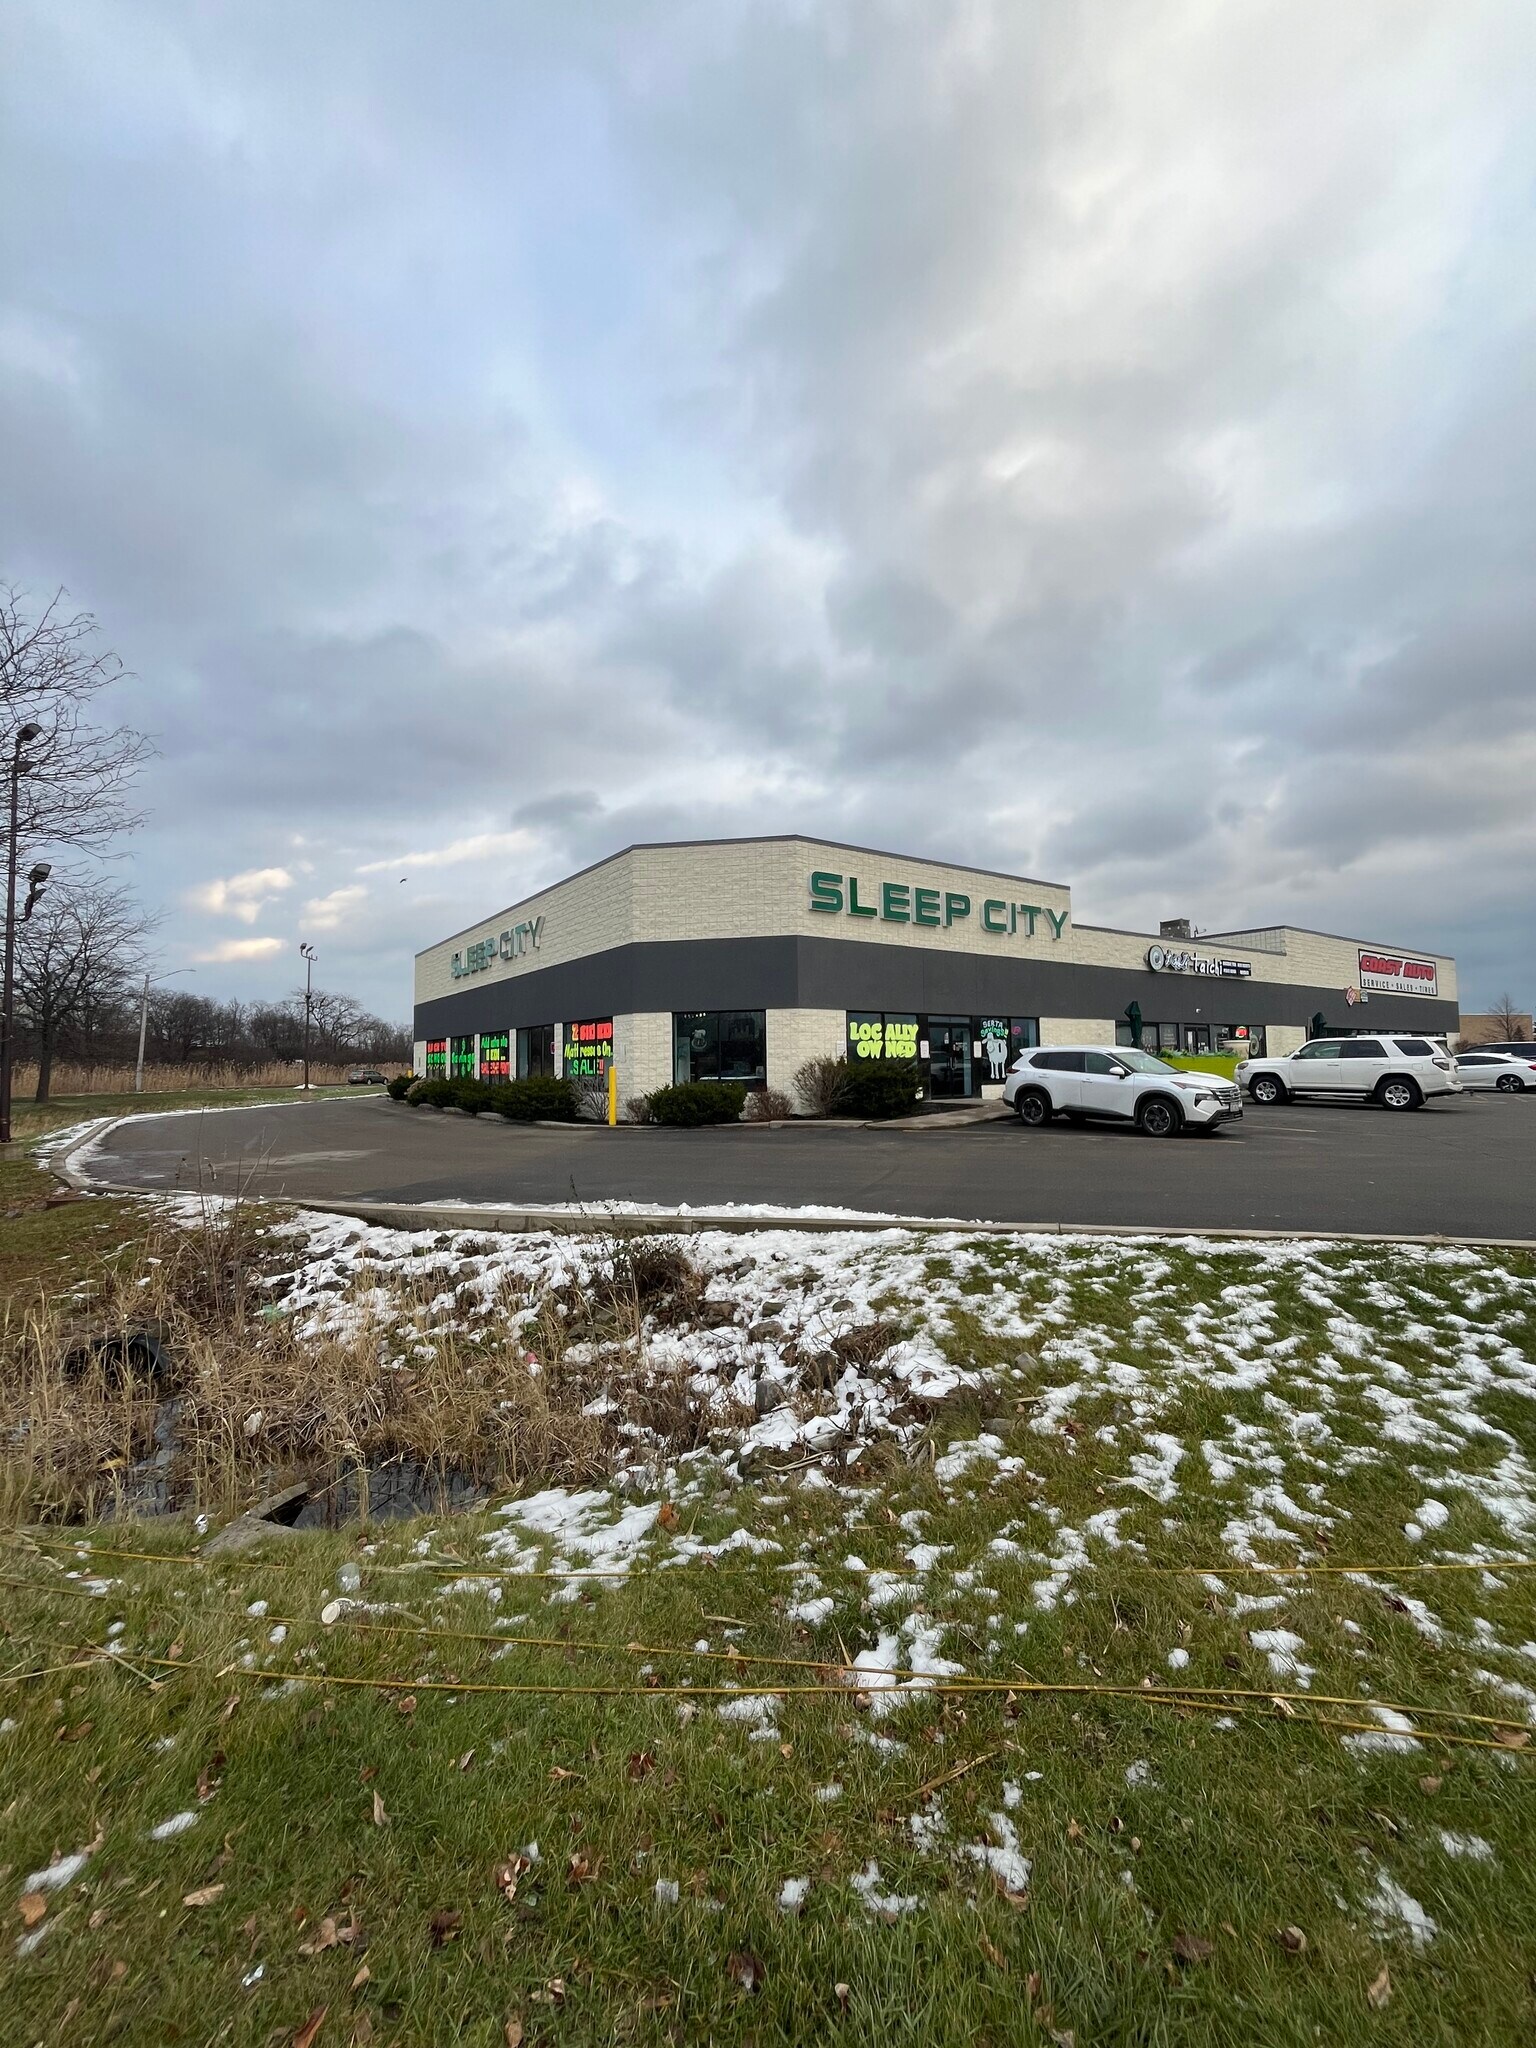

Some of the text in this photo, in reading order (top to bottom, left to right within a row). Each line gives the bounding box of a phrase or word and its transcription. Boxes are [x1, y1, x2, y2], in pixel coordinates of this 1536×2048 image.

[809, 871, 1069, 940] SLEEP CITY
[451, 915, 546, 979] SLEEP CITY
[1190, 952, 1223, 976] taichi
[1360, 955, 1434, 981] COAST AUTO
[1363, 979, 1435, 994] SERVICE SALES TIRES
[982, 1019, 1003, 1029] SERTA
